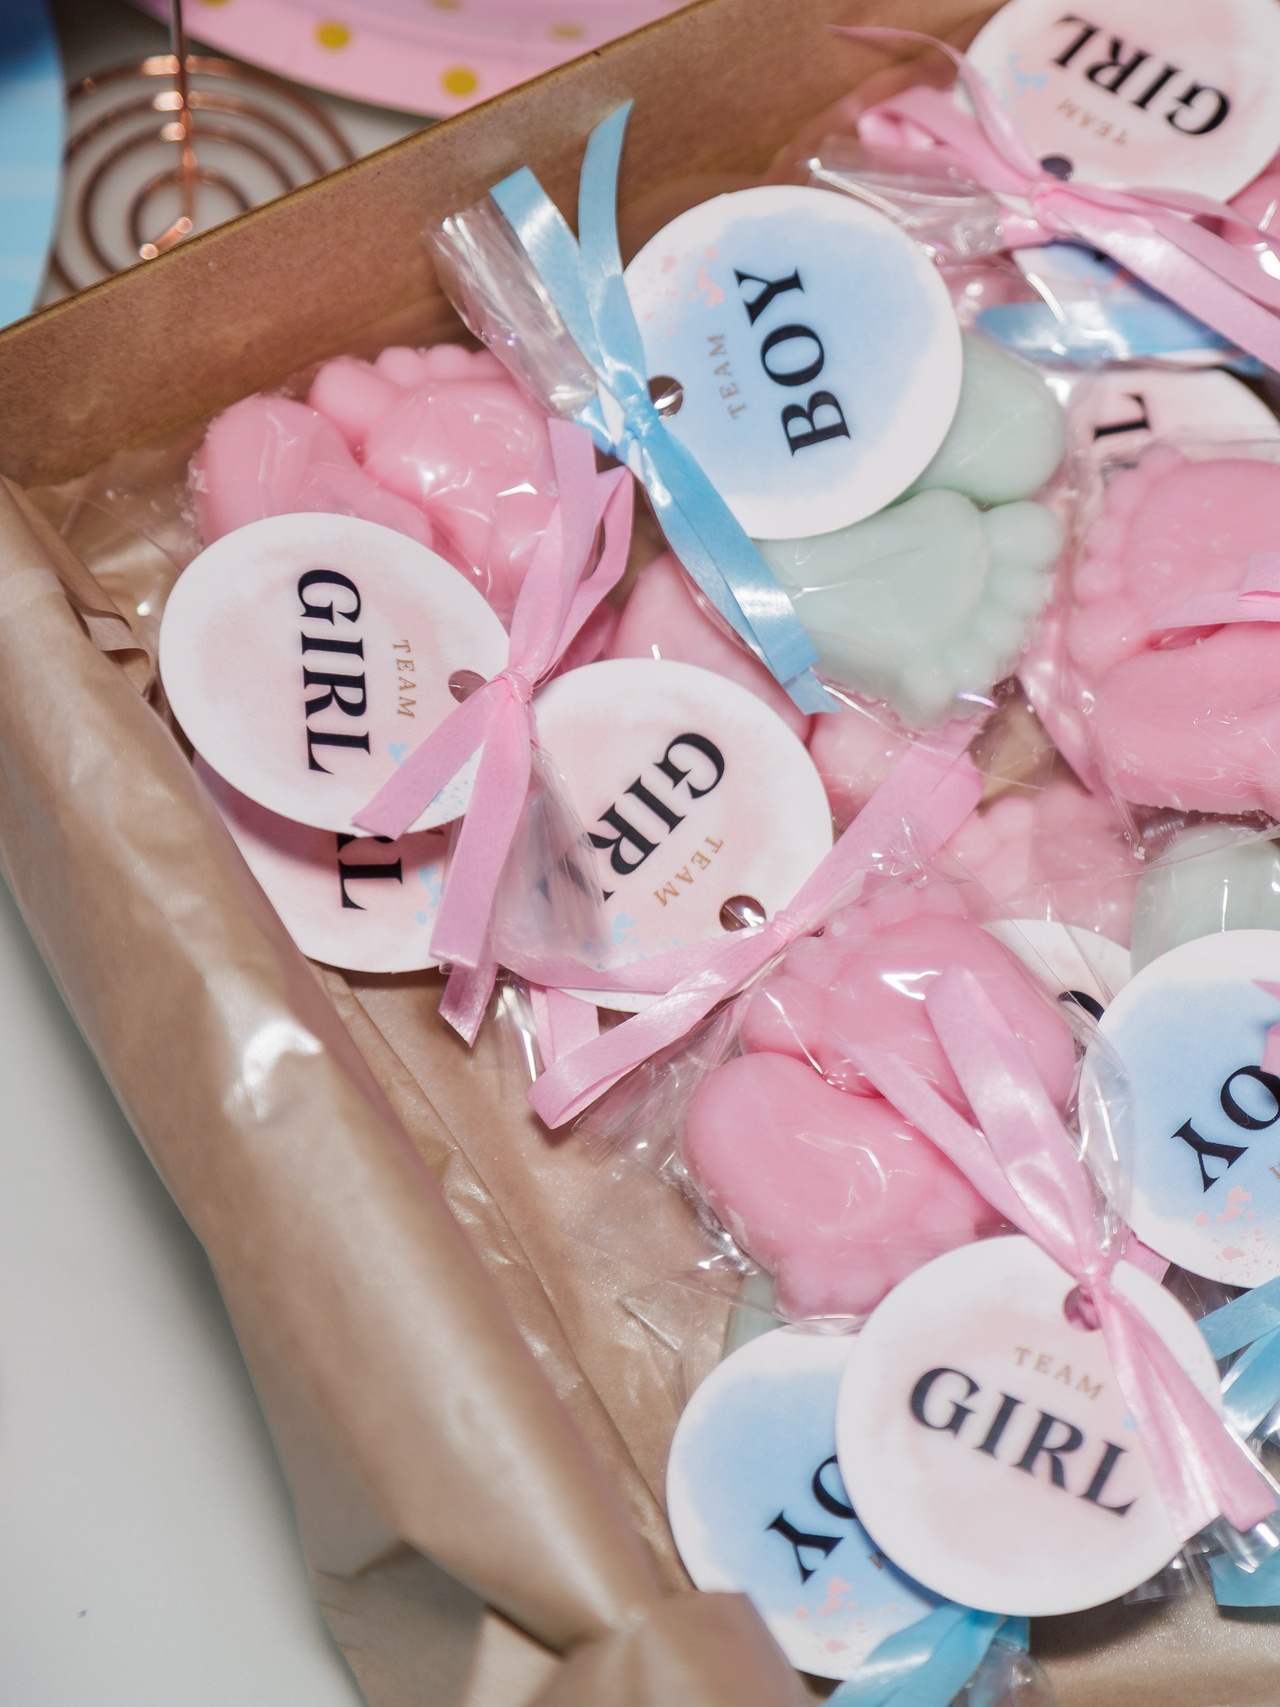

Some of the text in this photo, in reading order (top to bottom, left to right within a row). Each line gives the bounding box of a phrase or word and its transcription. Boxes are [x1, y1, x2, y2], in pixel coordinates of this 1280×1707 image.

[1052, 13, 1232, 136] GIRL
[1056, 98, 1130, 147] TEAM
[706, 333, 747, 420] TEAM
[733, 266, 852, 458] BOY
[296, 568, 372, 776] GIRL
[393, 638, 418, 719] TEAM
[652, 834, 724, 907] TEAM
[1014, 1345, 1105, 1401] TEAM
[908, 1366, 1140, 1518] GIRL
[765, 1454, 857, 1585] OY
